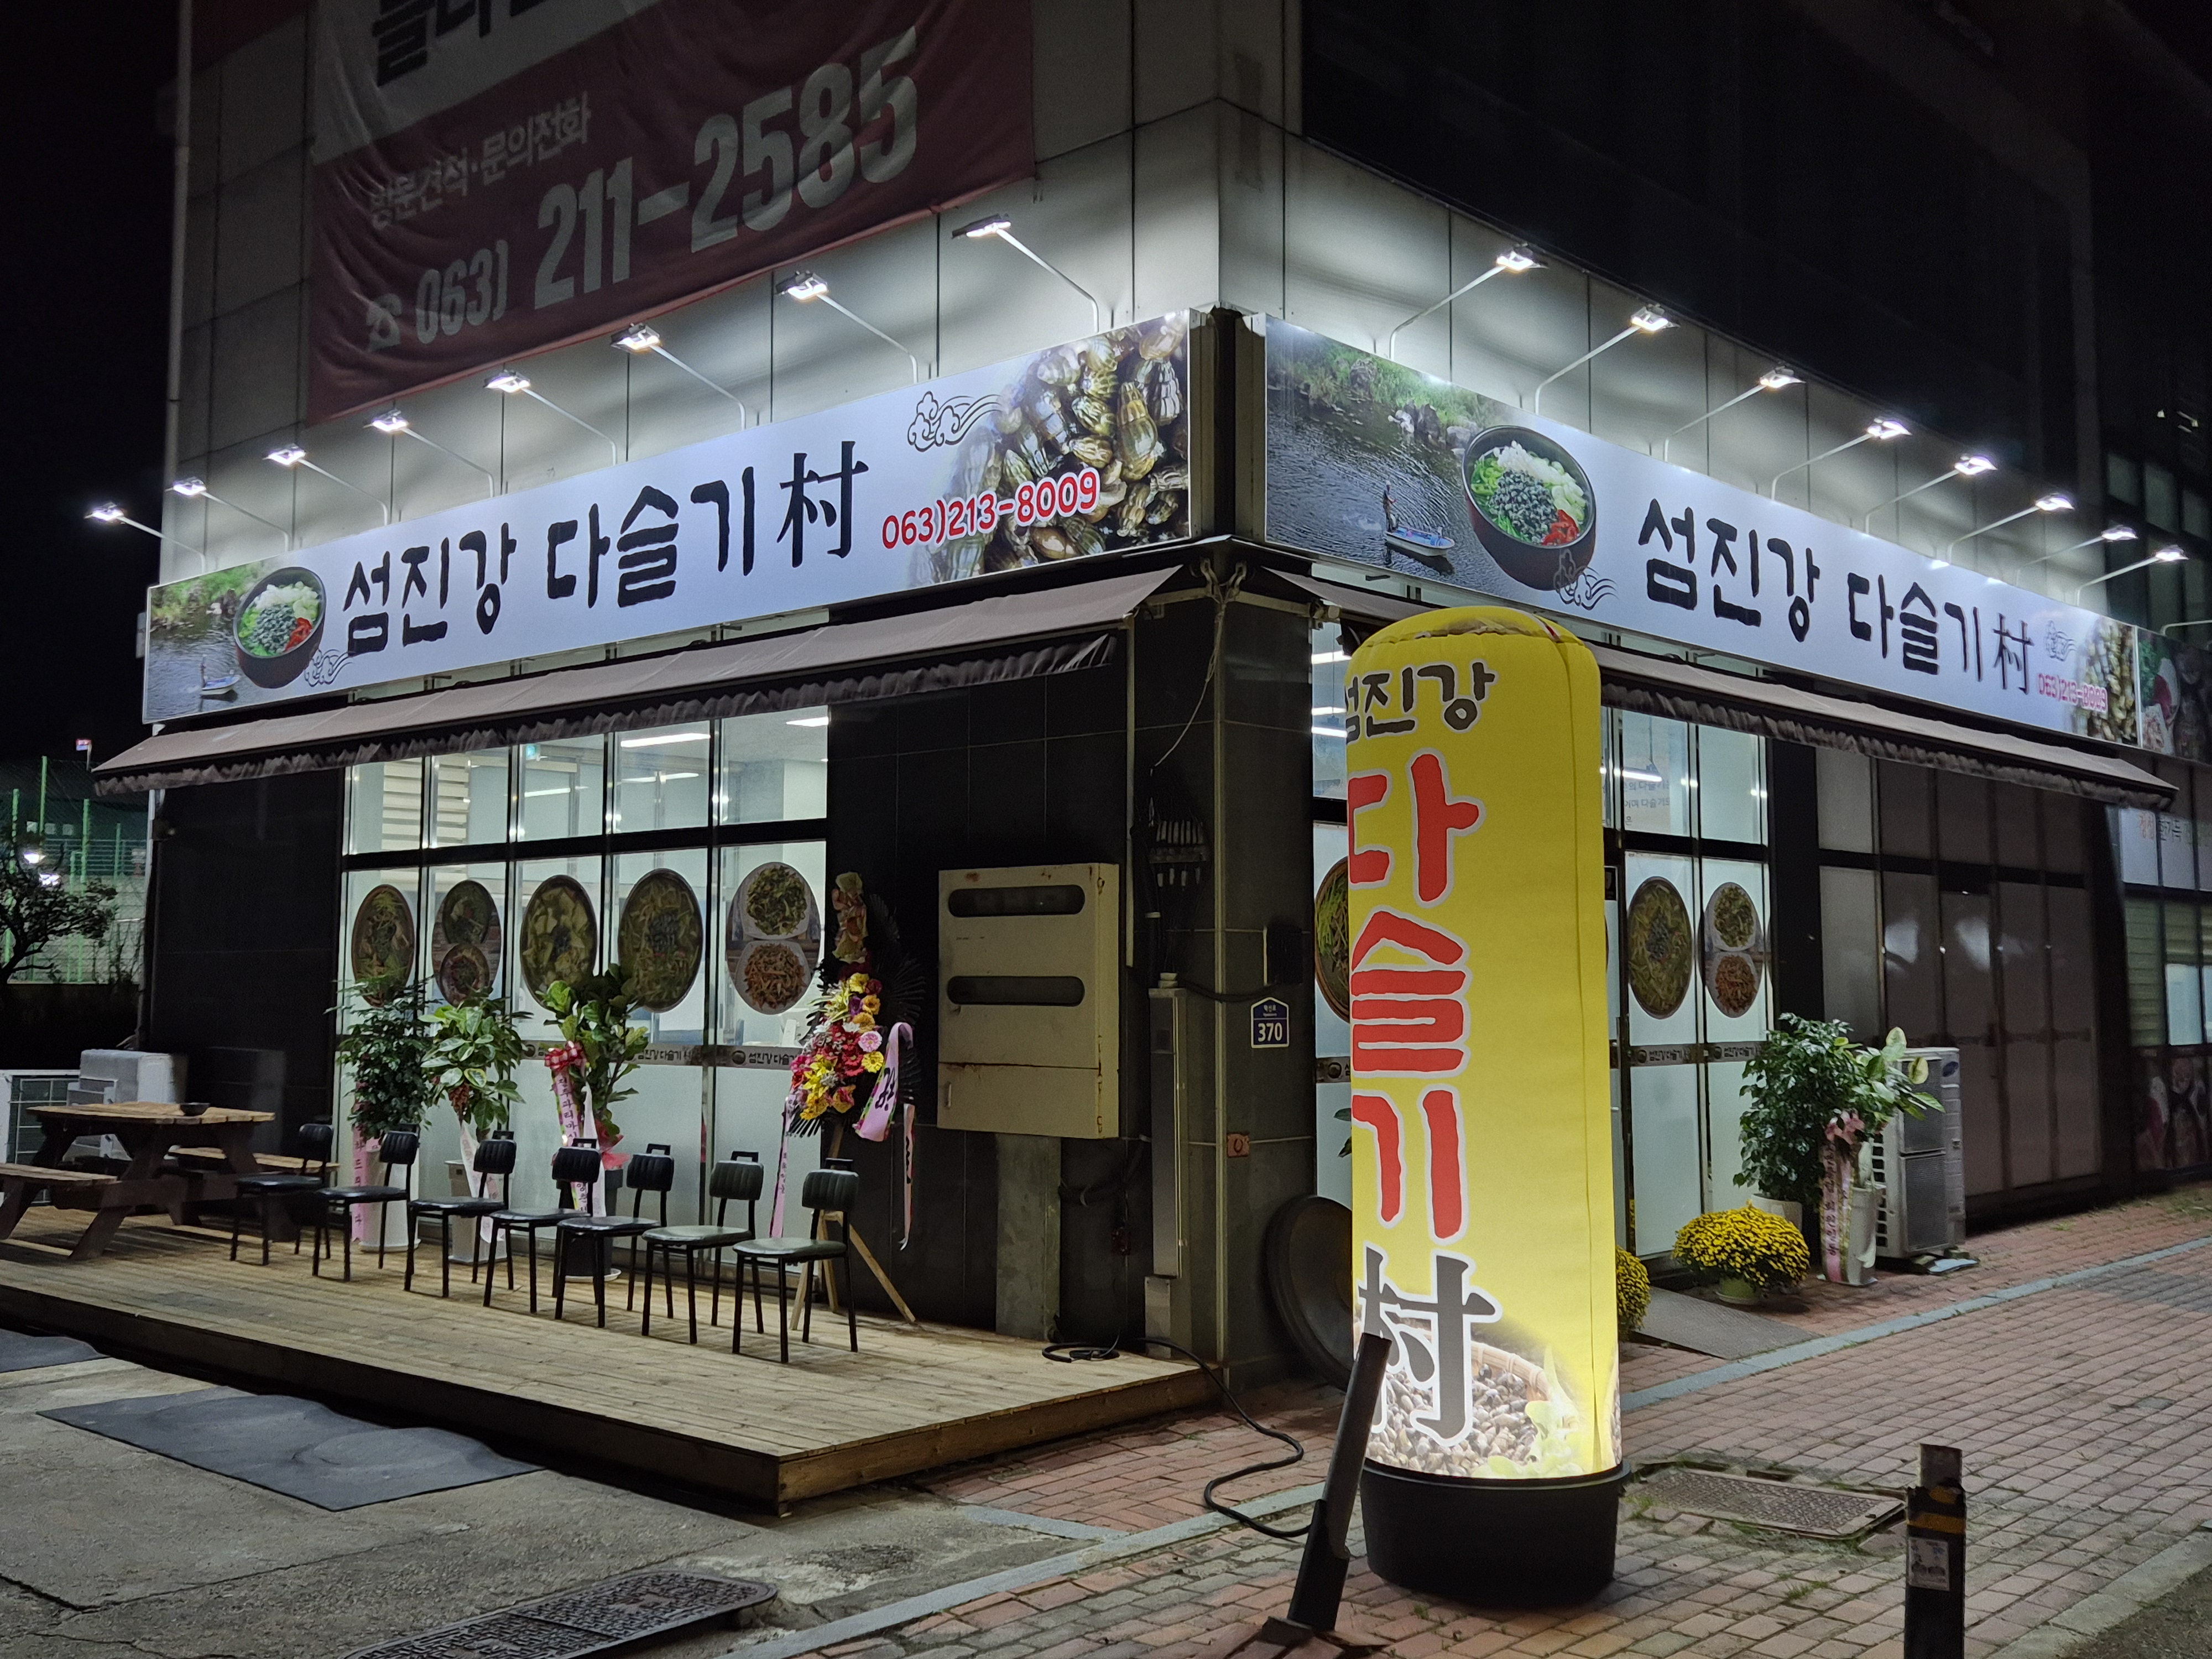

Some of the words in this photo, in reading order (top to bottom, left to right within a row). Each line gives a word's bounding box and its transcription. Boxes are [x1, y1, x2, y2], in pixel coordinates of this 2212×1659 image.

[416, 239, 509, 344] 063)
[534, 26, 918, 310] 211-2585
[881, 468, 1099, 549] 063)213-8009
[342, 522, 517, 657] 섬진강
[1637, 498, 1820, 643] 섬진강
[2038, 672, 2107, 712] 063)213-8009
[1258, 1022, 1283, 1042] 370
